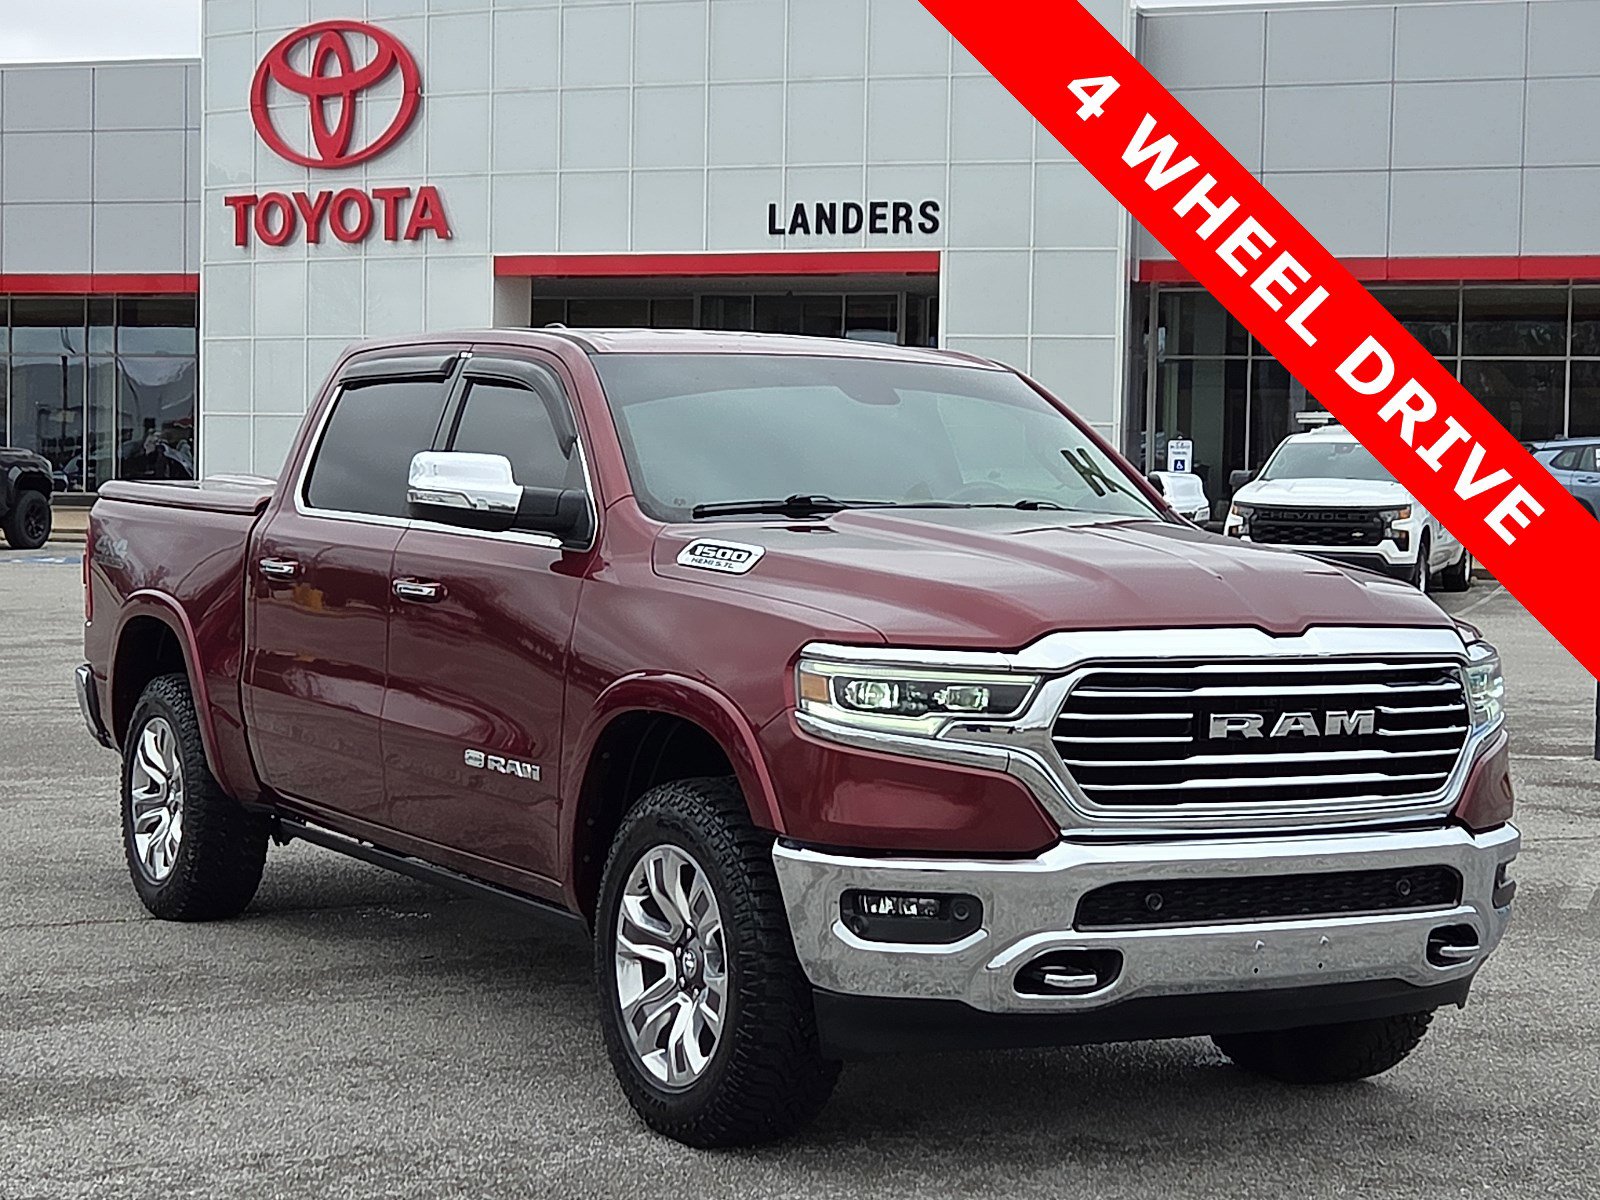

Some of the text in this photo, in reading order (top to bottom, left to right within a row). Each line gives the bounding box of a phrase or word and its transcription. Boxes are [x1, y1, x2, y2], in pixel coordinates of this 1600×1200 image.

[225, 186, 452, 247] TOYOTA
[768, 200, 940, 235] LANDERS
[1259, 511, 1370, 520] CHEVROLET
[691, 557, 714, 566] HEMI
[694, 545, 750, 563] 1500
[1208, 710, 1375, 739] RAM
[487, 755, 540, 782] RAM
